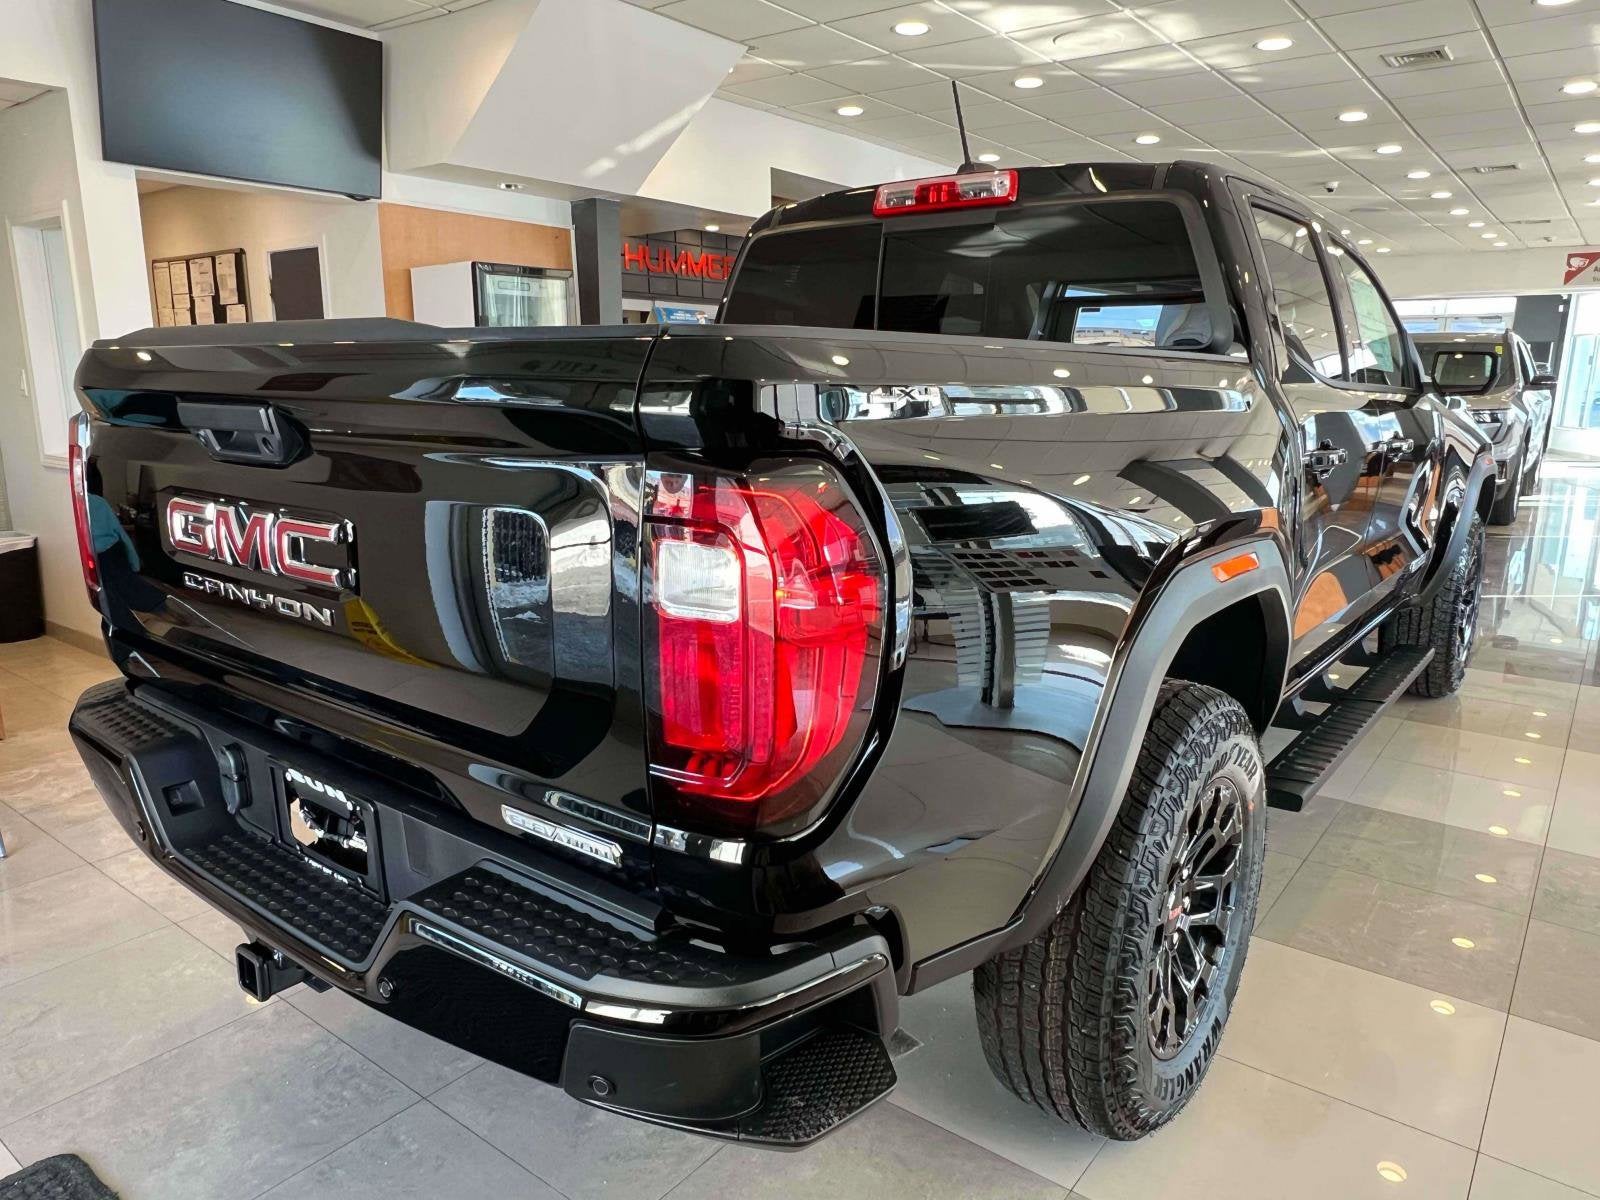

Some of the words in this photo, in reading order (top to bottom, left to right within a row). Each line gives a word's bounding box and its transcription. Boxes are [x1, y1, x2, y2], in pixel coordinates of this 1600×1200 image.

[167, 497, 343, 589] GMC
[184, 571, 335, 627] CANYON
[1153, 1015, 1222, 1101] WRANGLER
